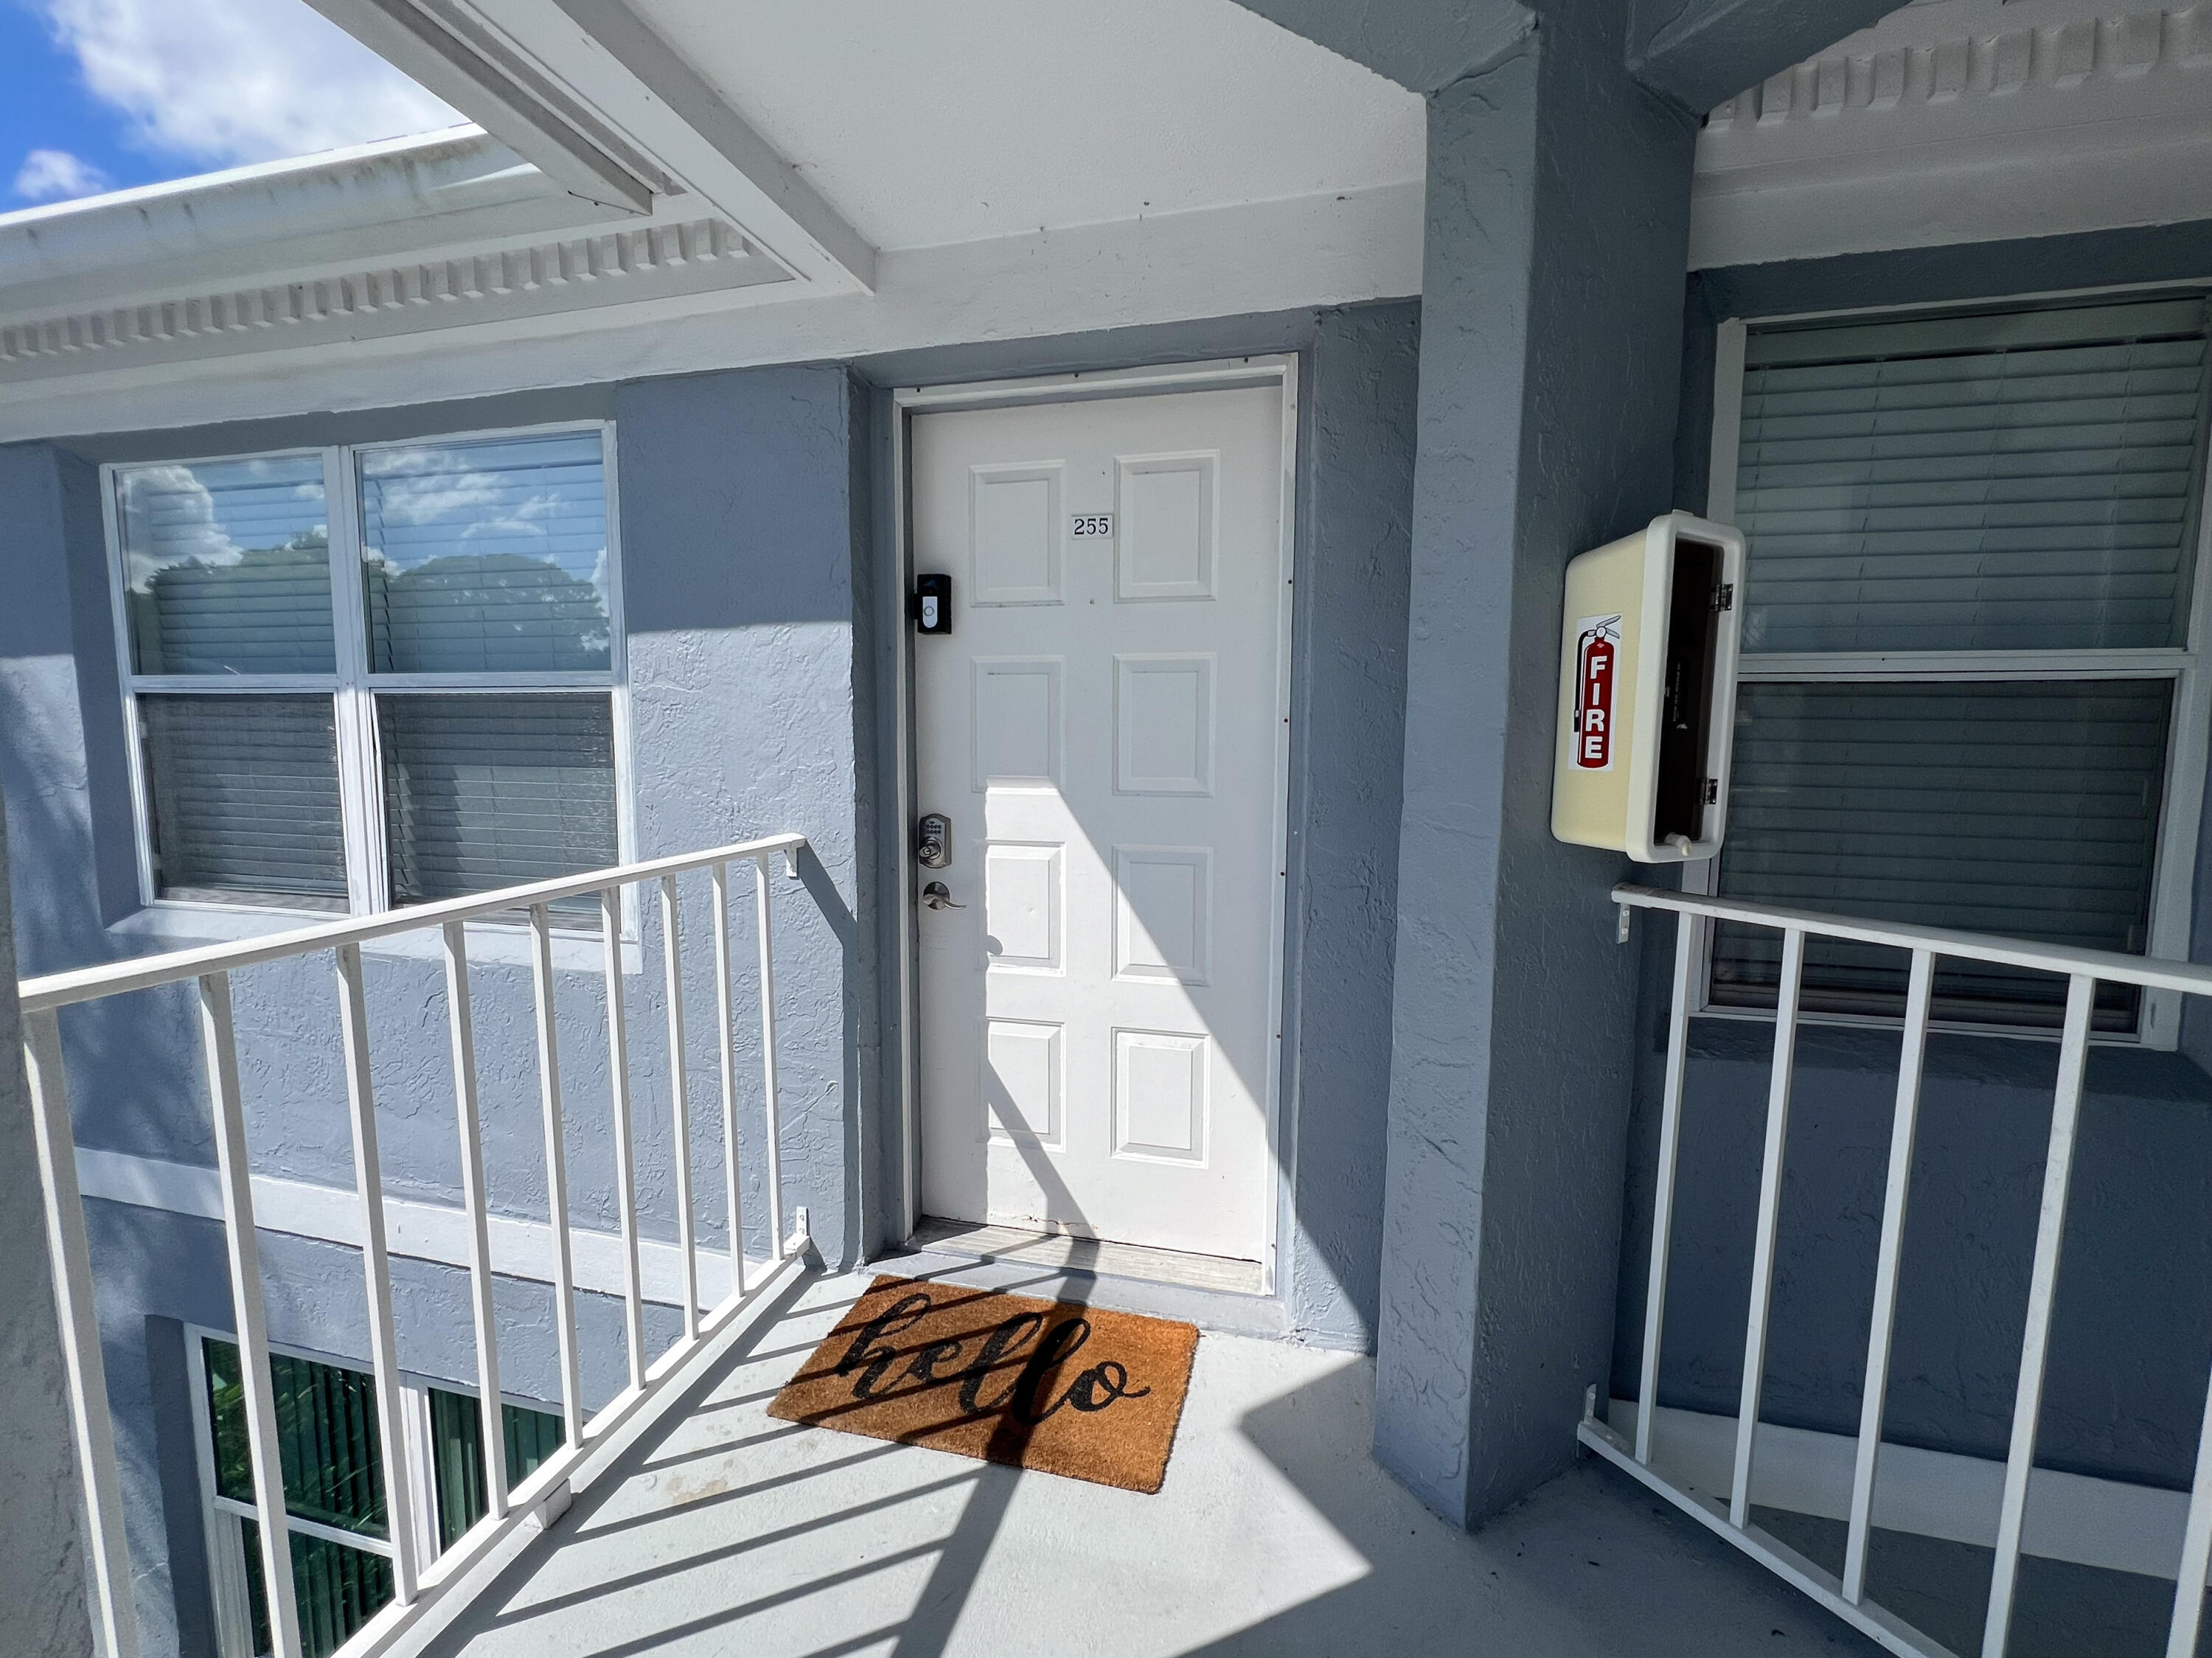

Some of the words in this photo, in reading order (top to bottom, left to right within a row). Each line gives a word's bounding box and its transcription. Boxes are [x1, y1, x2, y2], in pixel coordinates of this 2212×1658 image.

[1074, 518, 1108, 534] 255
[1585, 655, 1607, 759] FIRE
[835, 1293, 1150, 1425] hello
